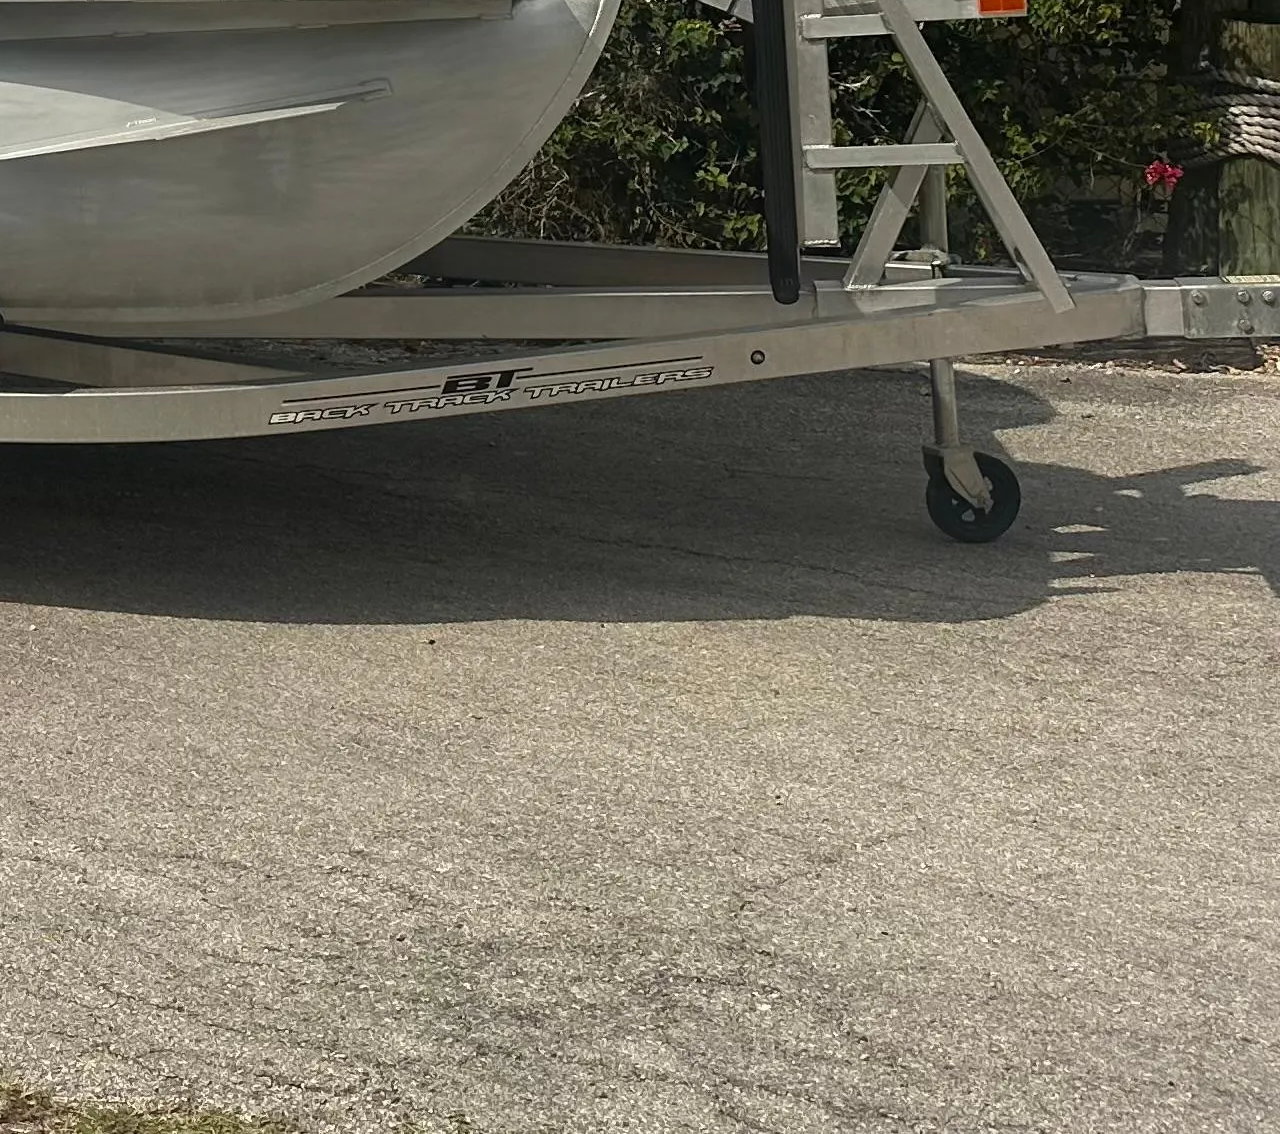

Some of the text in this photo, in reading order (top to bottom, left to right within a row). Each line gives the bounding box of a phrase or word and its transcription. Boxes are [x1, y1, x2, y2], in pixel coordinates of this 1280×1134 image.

[268, 365, 715, 426] BACK TRACK TRAILERS
[441, 367, 534, 395] BT
